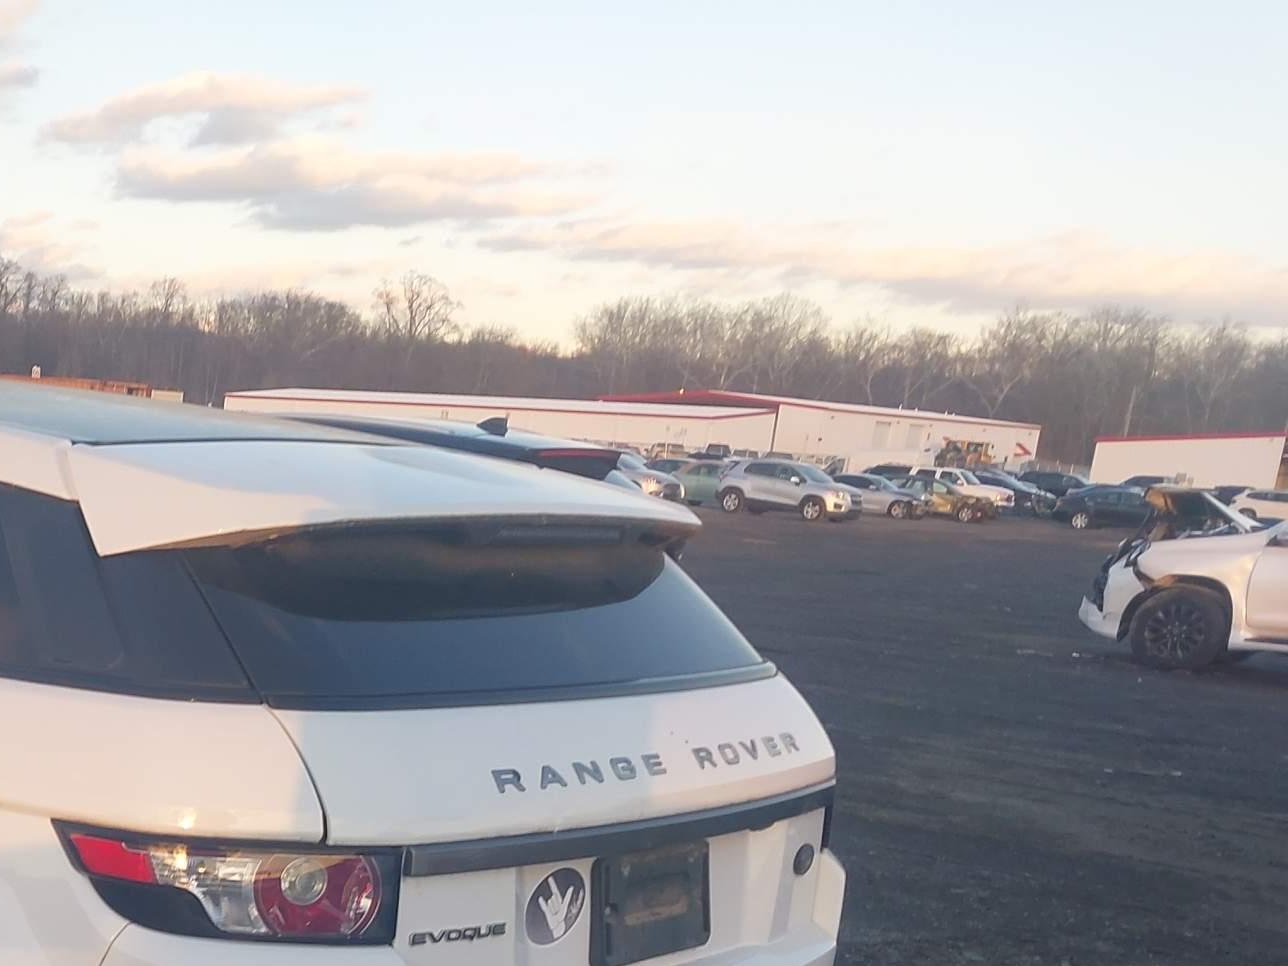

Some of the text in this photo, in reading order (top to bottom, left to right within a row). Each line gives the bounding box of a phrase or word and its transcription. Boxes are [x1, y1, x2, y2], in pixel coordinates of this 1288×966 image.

[490, 731, 801, 794] RANGE ROVER
[408, 922, 507, 946] EVOQUE
